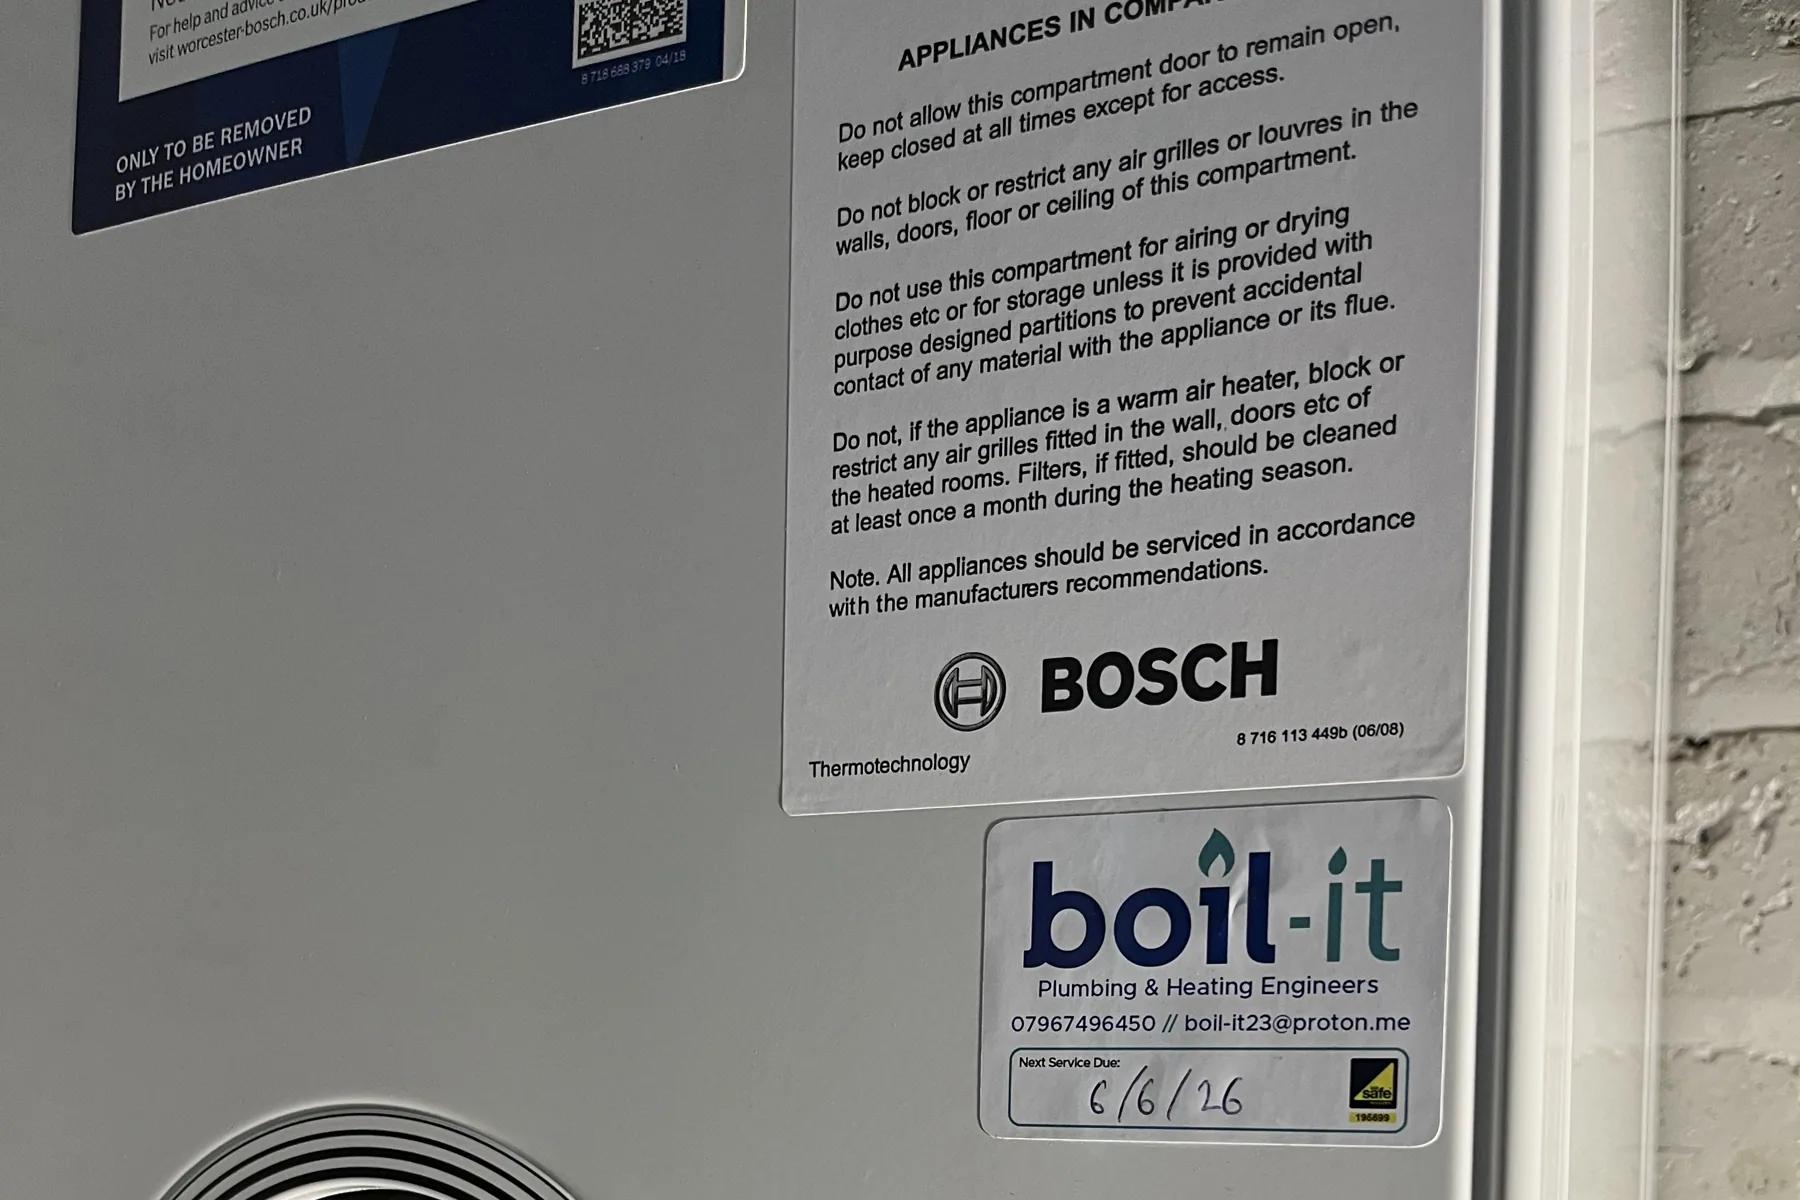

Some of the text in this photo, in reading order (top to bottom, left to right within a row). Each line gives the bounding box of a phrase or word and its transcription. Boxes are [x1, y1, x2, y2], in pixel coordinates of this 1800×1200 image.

[148, 43, 175, 65] visit
[150, 25, 171, 41] For
[174, 13, 201, 34] help
[204, 2, 229, 24] and
[897, 15, 1062, 72] APPLIANCES
[1069, 6, 1096, 34] IN
[838, 15, 1400, 144] Do not allow this compartment door to remain open,
[116, 106, 312, 174] ONLY TO BE REMOVED
[838, 66, 1285, 172] keep closed at all times except for access.
[115, 137, 303, 202] BY THE HOMEOWNER
[835, 139, 1357, 257] walls, doors, floor or ceiling of this compartment.
[834, 229, 1373, 341] clothes etc or for storage unless it is provided with
[835, 205, 1350, 313] Do not use this compartment for airing or drying
[833, 293, 1396, 397] contact of any material with the appliance or its flue.
[834, 260, 1363, 374] purpose designed partitions to prevent accidental
[831, 413, 1398, 508] the heated rooms. Filters, if fitted, should be cleaned
[832, 384, 1373, 481] restrict any air grilles fitted in the wall, doors etc of
[830, 456, 1353, 536] at least once a month during the heating season.
[828, 557, 1269, 618] with the manufacturers recommendations.
[830, 511, 1416, 591] Note. All appliances should be serviced in accordance
[1041, 638, 1279, 713] BOSCH
[808, 753, 971, 778] Thermotechnology
[1236, 722, 1404, 746] 8 716 113 449b (06/08)
[1023, 828, 1403, 968] boil-it
[1011, 1015, 1156, 1032] 07967496450
[1184, 1014, 1411, 1034] boil-it23@proton.me
[1038, 976, 1379, 1000] Plumbing & Heating Engineers
[1019, 1057, 1120, 1068] Next Service Due:
[1362, 1087, 1392, 1099] safe
